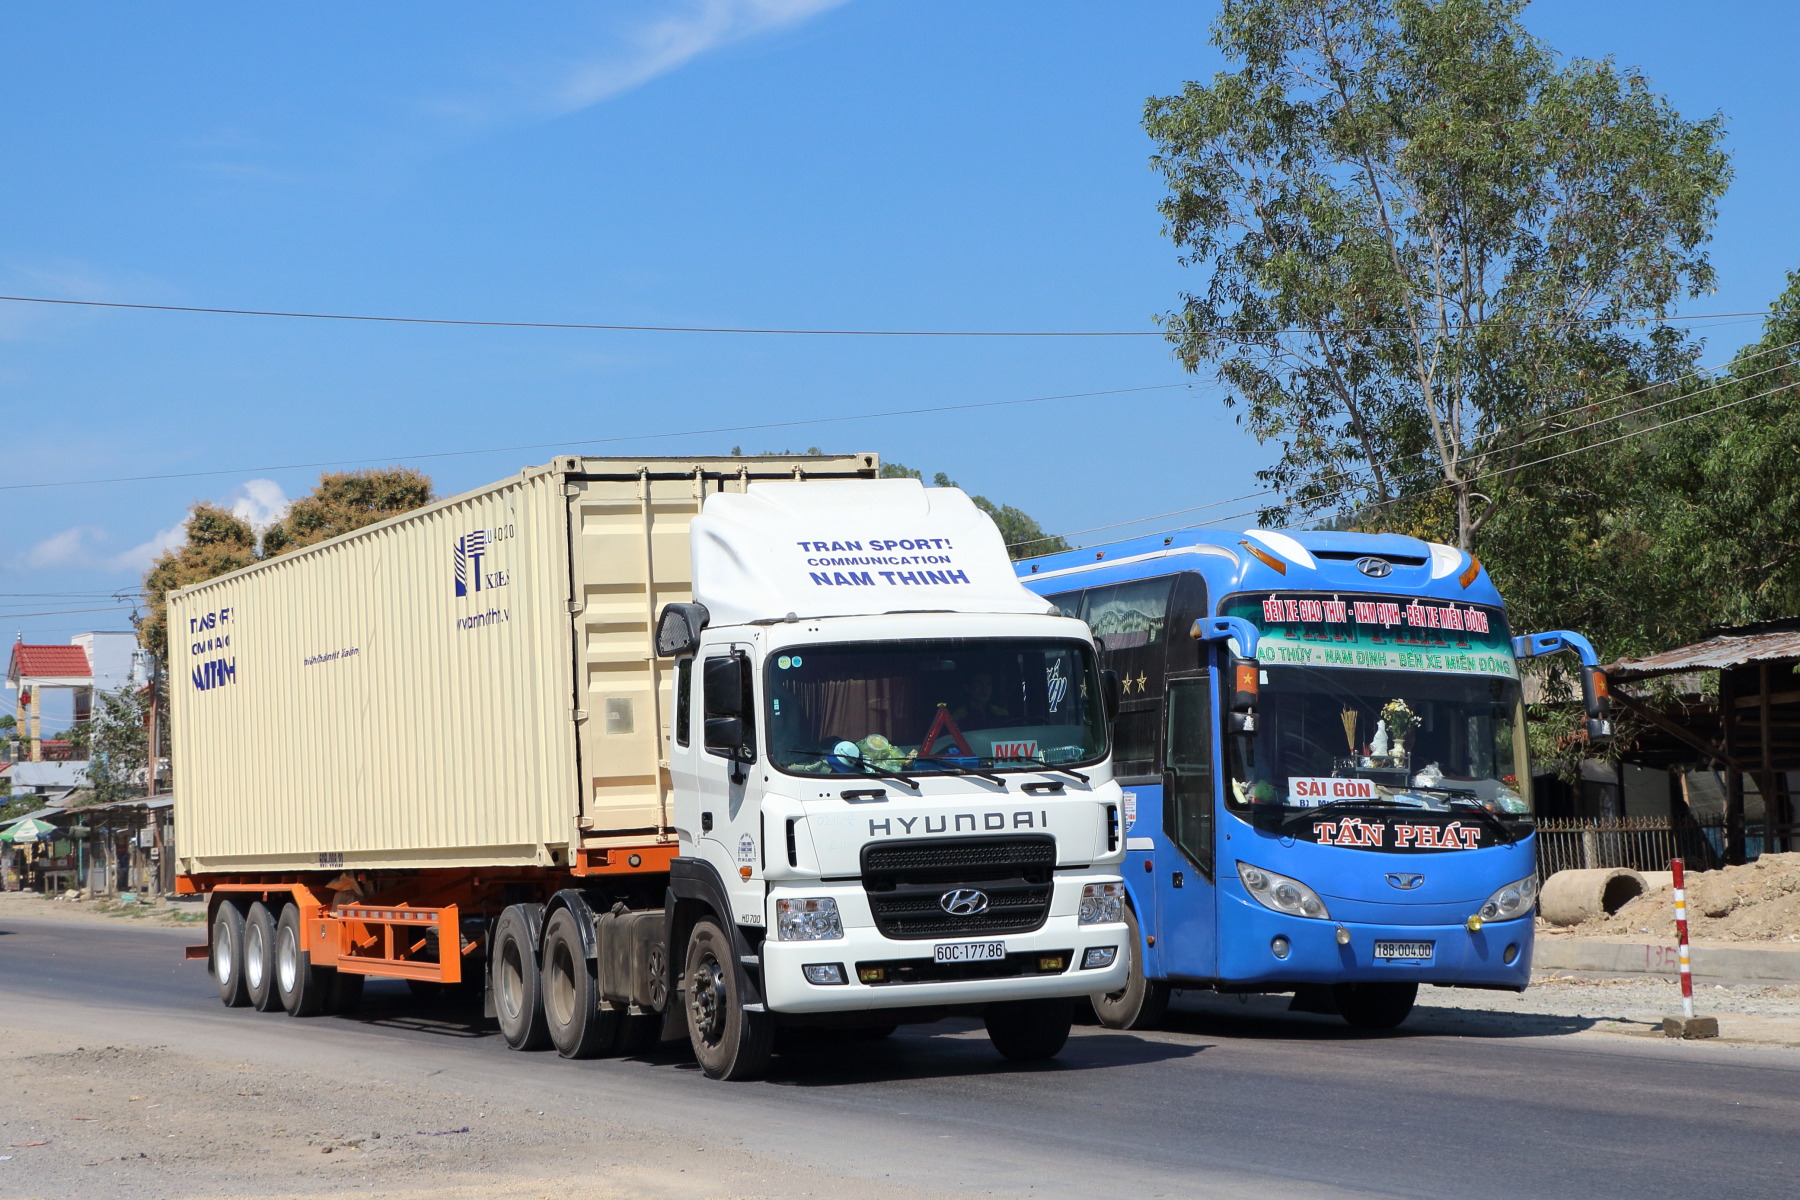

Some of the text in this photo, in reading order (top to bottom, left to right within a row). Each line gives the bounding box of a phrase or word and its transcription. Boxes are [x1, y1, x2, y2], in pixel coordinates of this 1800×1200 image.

[797, 539, 953, 552] TRAN SPORT!
[807, 556, 952, 566] COMMUNICATION
[809, 570, 970, 586] NAM THINH
[1284, 600, 1299, 622] XE
[1299, 600, 1322, 622] GIAO
[1353, 602, 1378, 623] NAM
[1425, 606, 1440, 628] XE
[1324, 649, 1353, 664] NAM
[1399, 648, 1423, 668] BẾN
[1426, 654, 1442, 669] XE
[1479, 655, 1511, 674] ĐÔNG
[995, 743, 1036, 762] NKV
[1296, 778, 1370, 797] SÀI GÒN
[869, 810, 1047, 837] HYUNDAI
[1394, 821, 1480, 849] PHÁT
[741, 914, 760, 924] HD700
